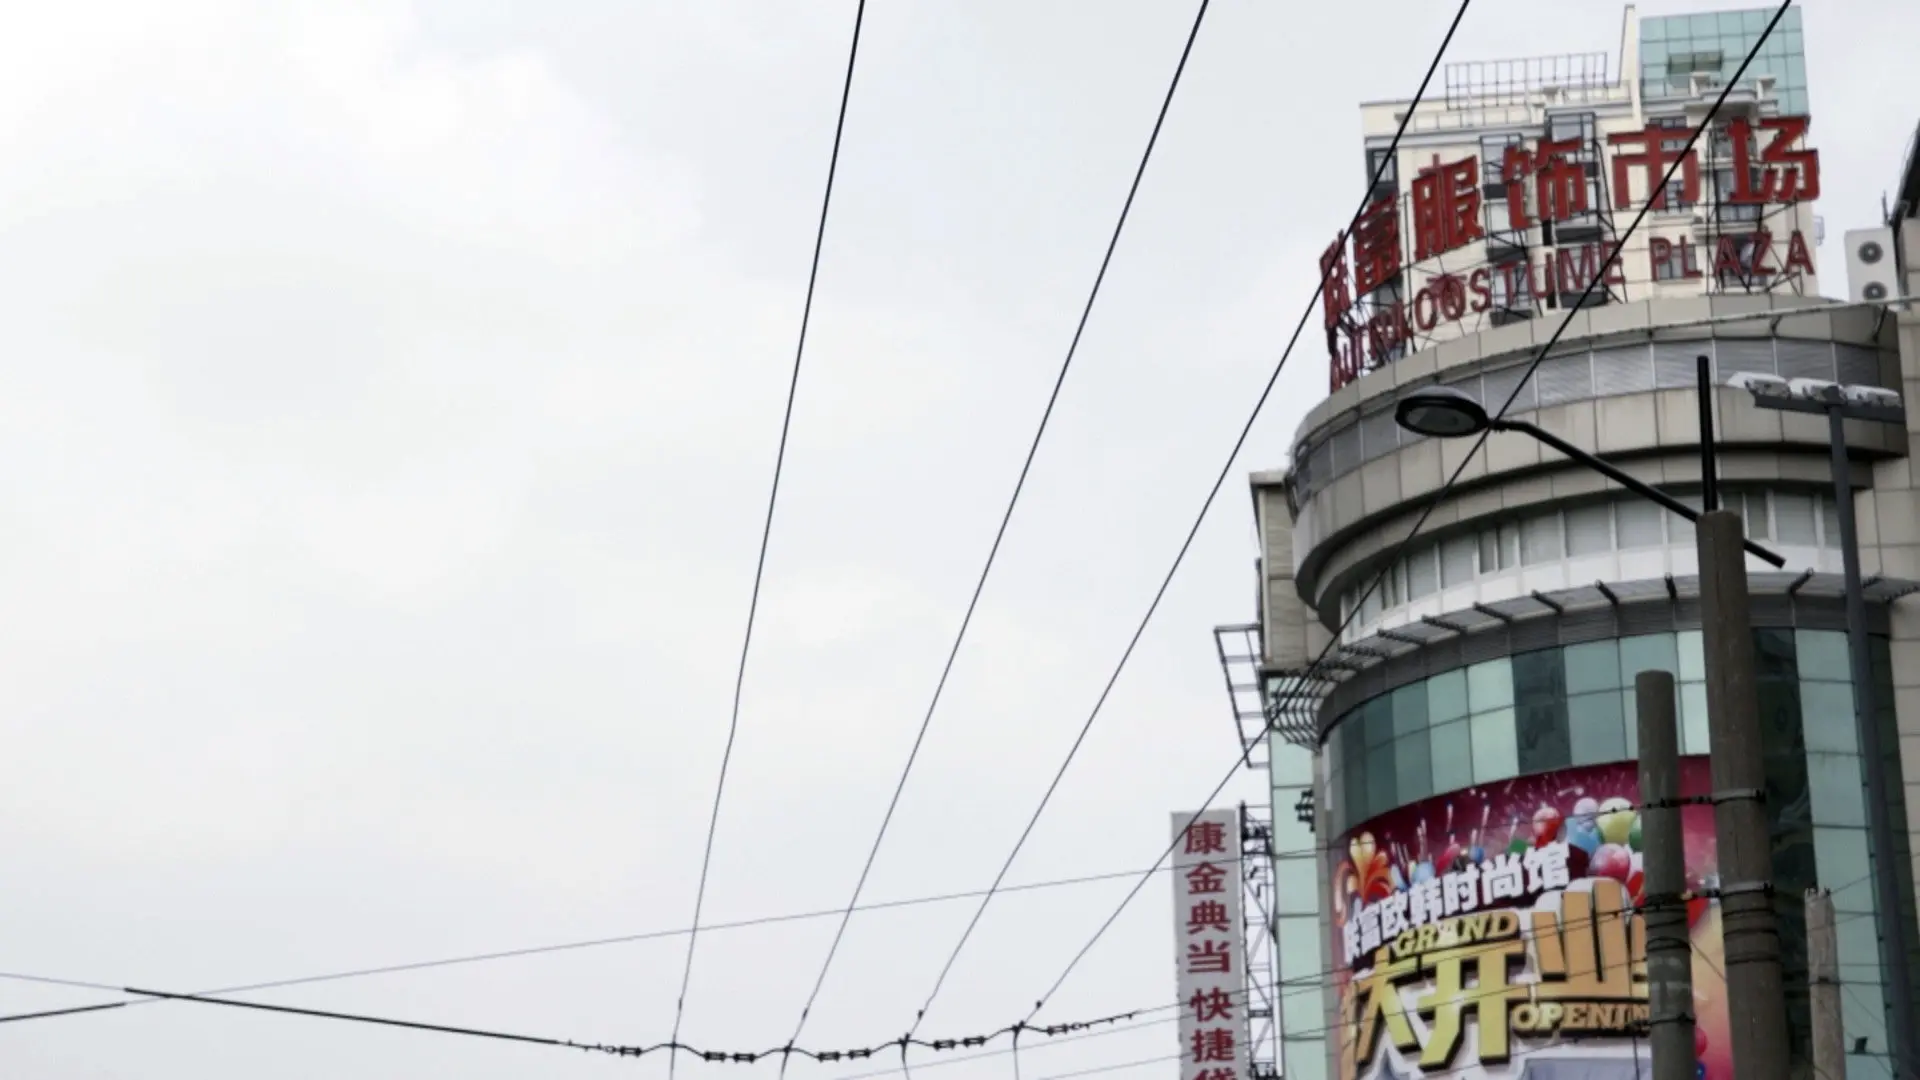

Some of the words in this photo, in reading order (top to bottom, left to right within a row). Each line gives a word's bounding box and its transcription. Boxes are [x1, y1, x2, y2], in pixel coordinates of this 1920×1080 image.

[1648, 229, 1815, 283] PLAZA
[1184, 819, 1231, 975] 康金典当
[1392, 911, 1519, 959] GRAND
[1511, 1001, 1650, 1032] OPENIN
